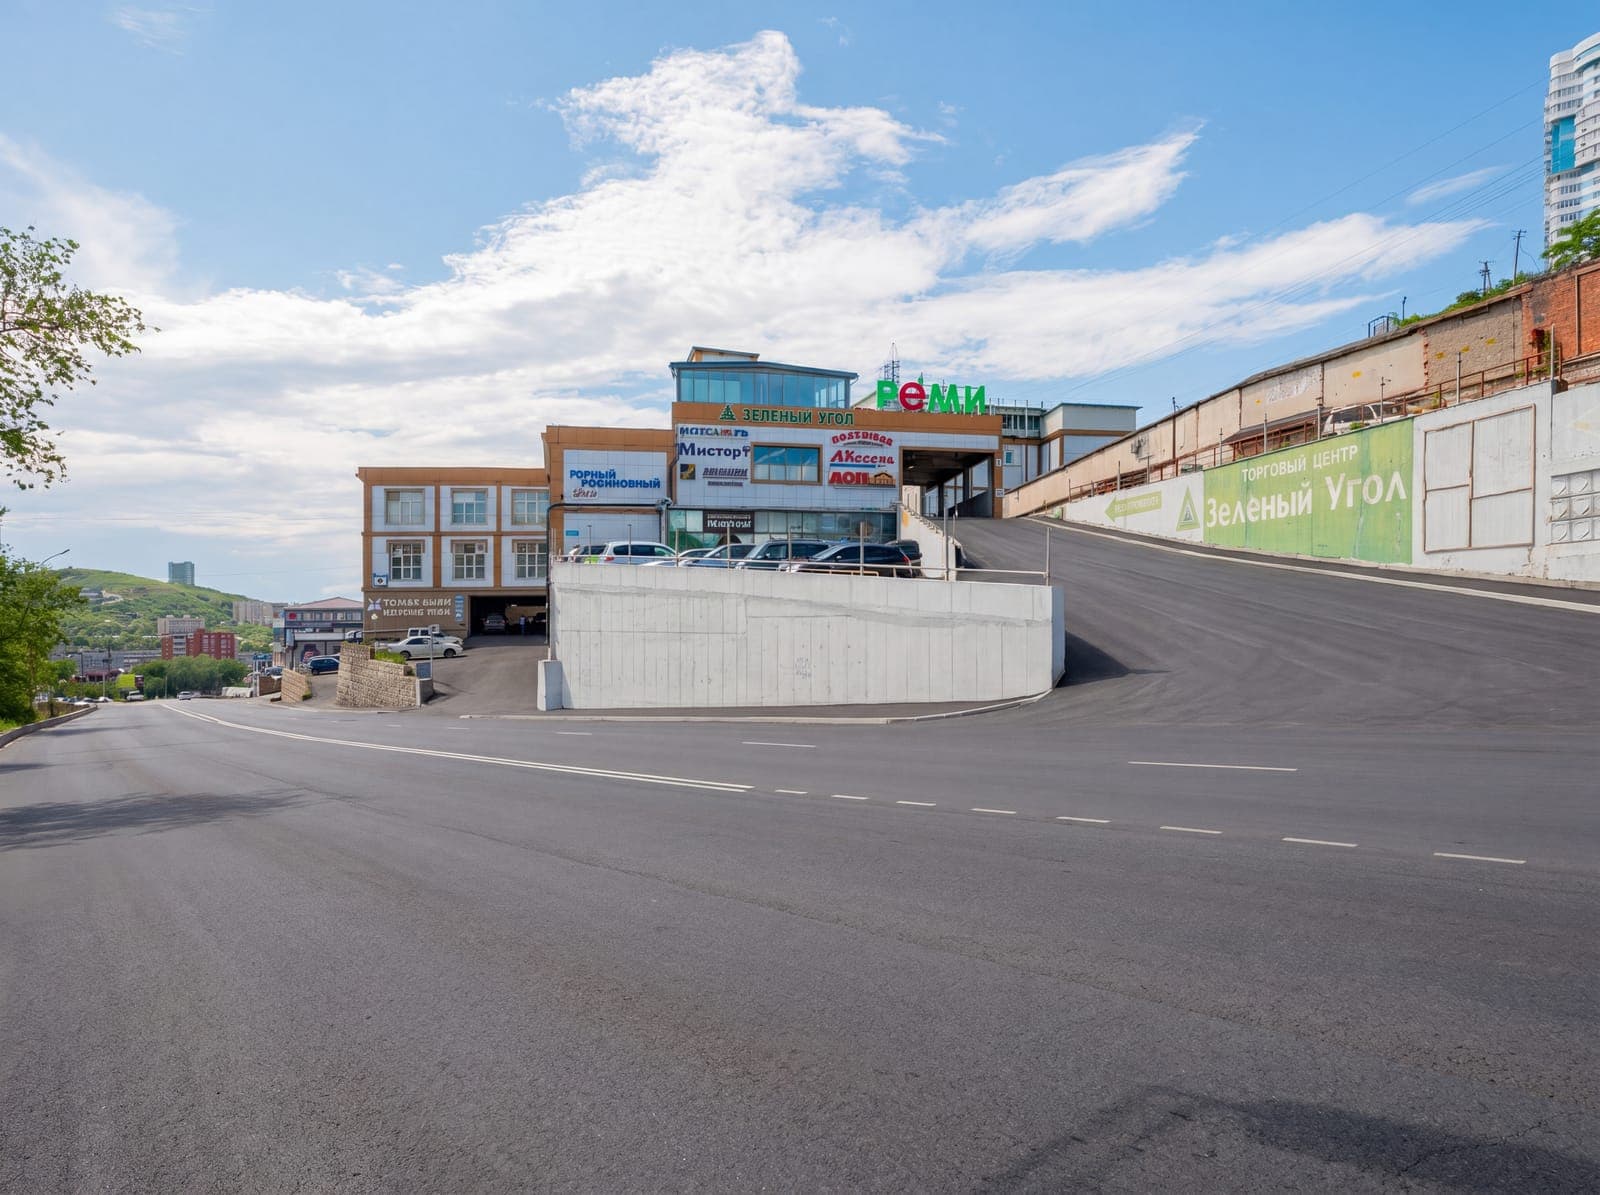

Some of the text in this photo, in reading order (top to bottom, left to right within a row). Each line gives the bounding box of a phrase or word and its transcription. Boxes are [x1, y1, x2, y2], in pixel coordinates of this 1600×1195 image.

[743, 408, 854, 425] ЗЕЛЕНЫЙ УГОЛ
[1242, 445, 1358, 482] ТОРГОВЫЙ ЦЕНТР
[1207, 480, 1313, 527] Зеленый
